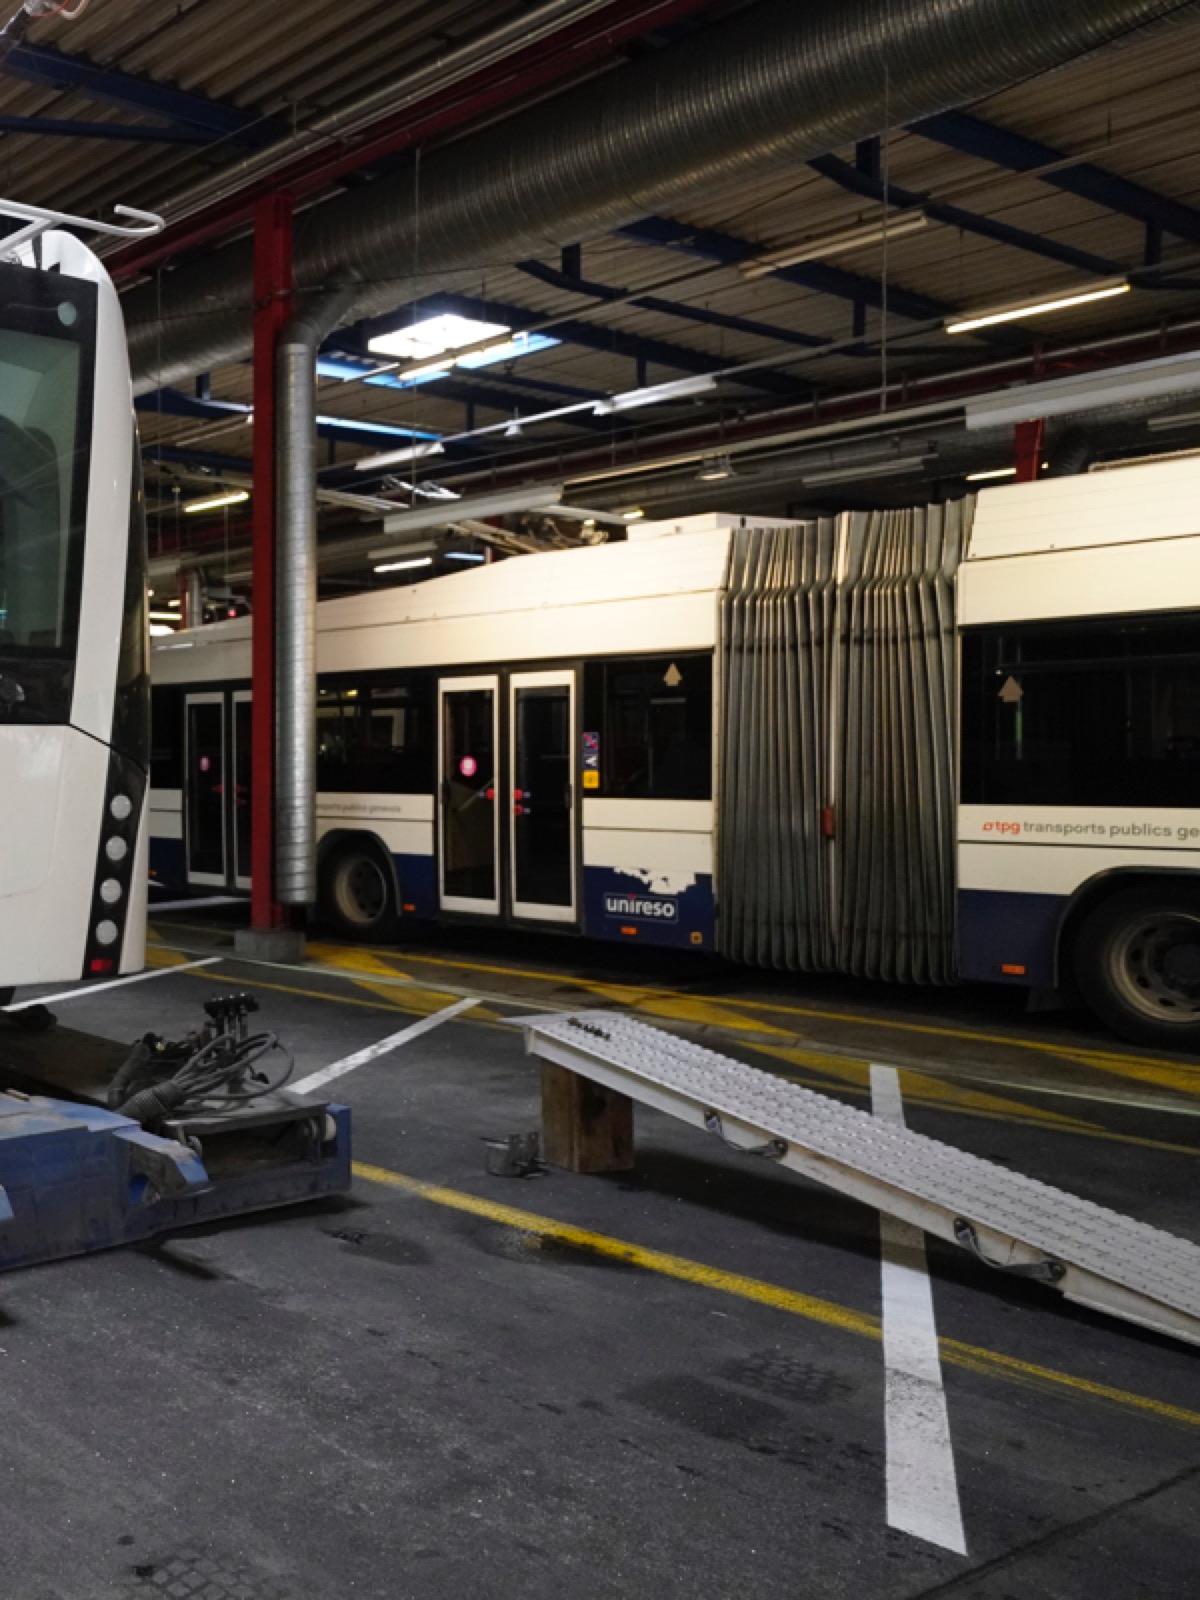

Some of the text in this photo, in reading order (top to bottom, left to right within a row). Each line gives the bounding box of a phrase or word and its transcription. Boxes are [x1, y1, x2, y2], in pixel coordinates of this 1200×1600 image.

[1023, 821, 1106, 836] transports
[1109, 822, 1173, 838] publics
[605, 893, 676, 918] unireso
